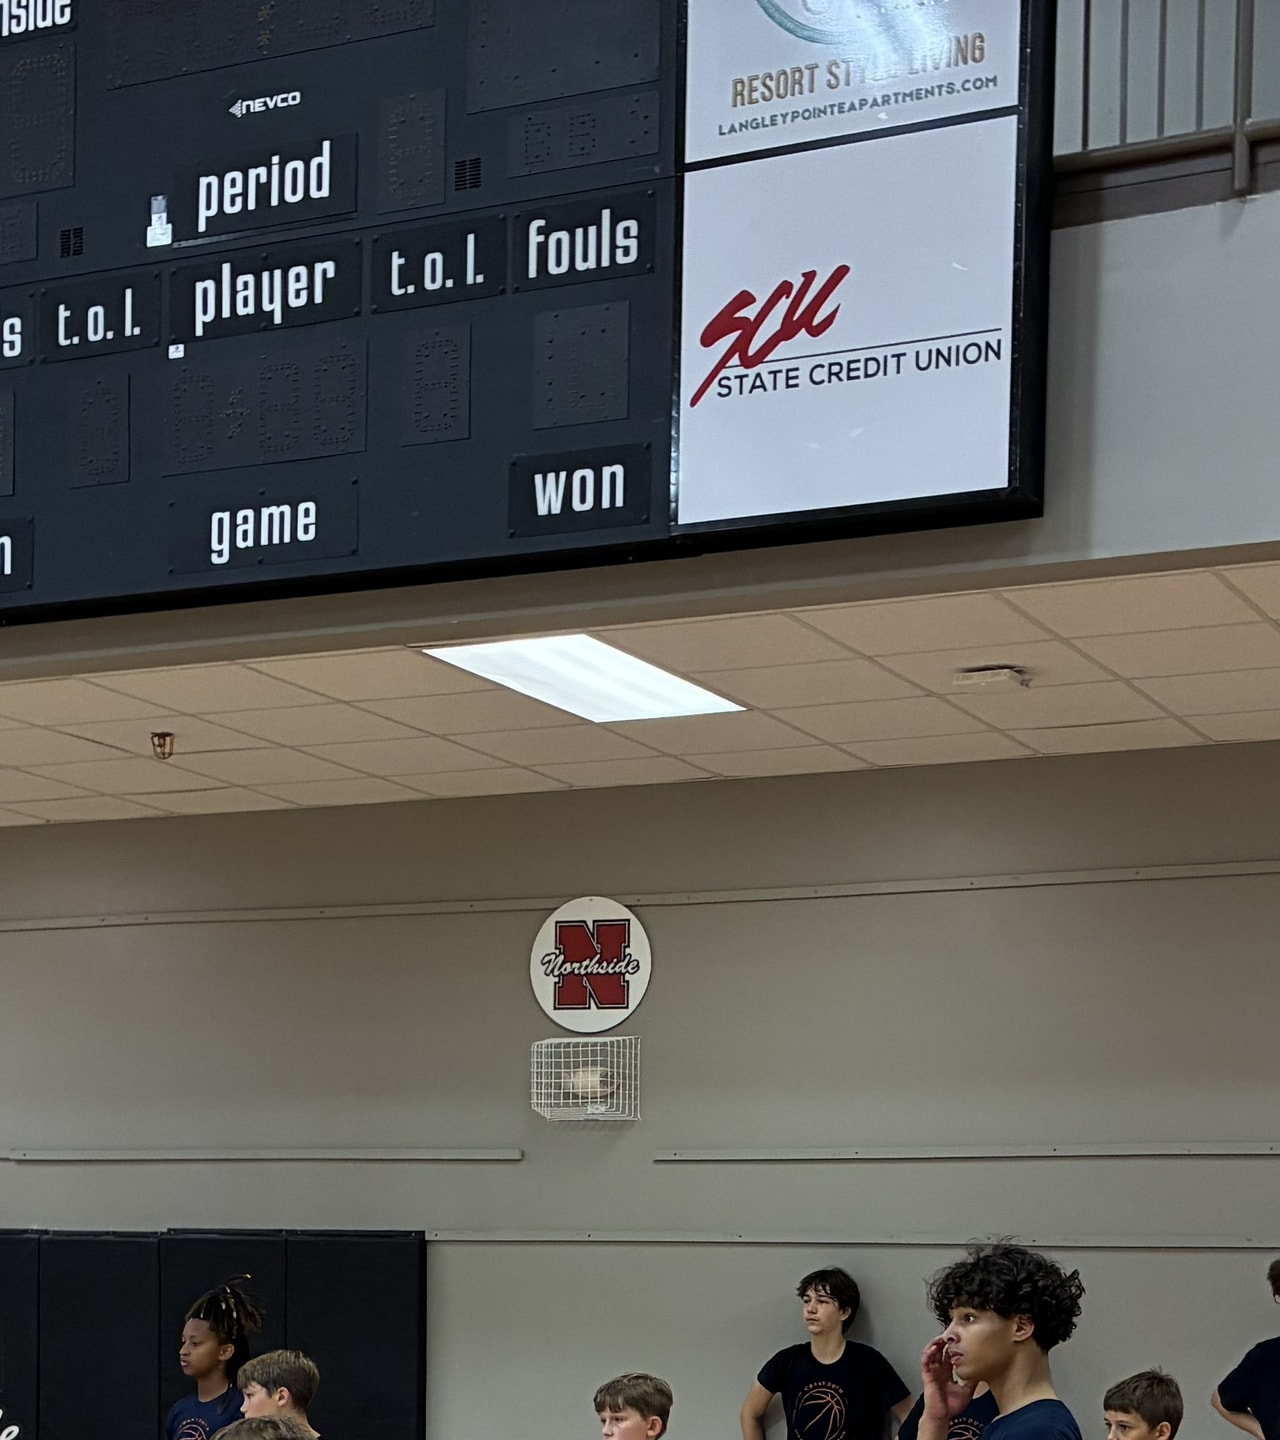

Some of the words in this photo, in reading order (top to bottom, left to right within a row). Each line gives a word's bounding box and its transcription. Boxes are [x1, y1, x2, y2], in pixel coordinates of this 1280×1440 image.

[242, 91, 302, 114] NEVCO
[718, 75, 998, 136] LANGLEYPOINTEAPARTMENTS.COM
[731, 62, 820, 107] RESORT
[198, 140, 331, 233] period
[528, 208, 639, 279] fouls
[195, 260, 336, 337] player
[689, 264, 851, 408] SCU
[717, 366, 800, 398] STATE
[809, 353, 907, 386] CREDIT
[915, 338, 1002, 371] UNION
[534, 463, 625, 516] won
[210, 500, 317, 565] game
[540, 951, 641, 978] Northside
